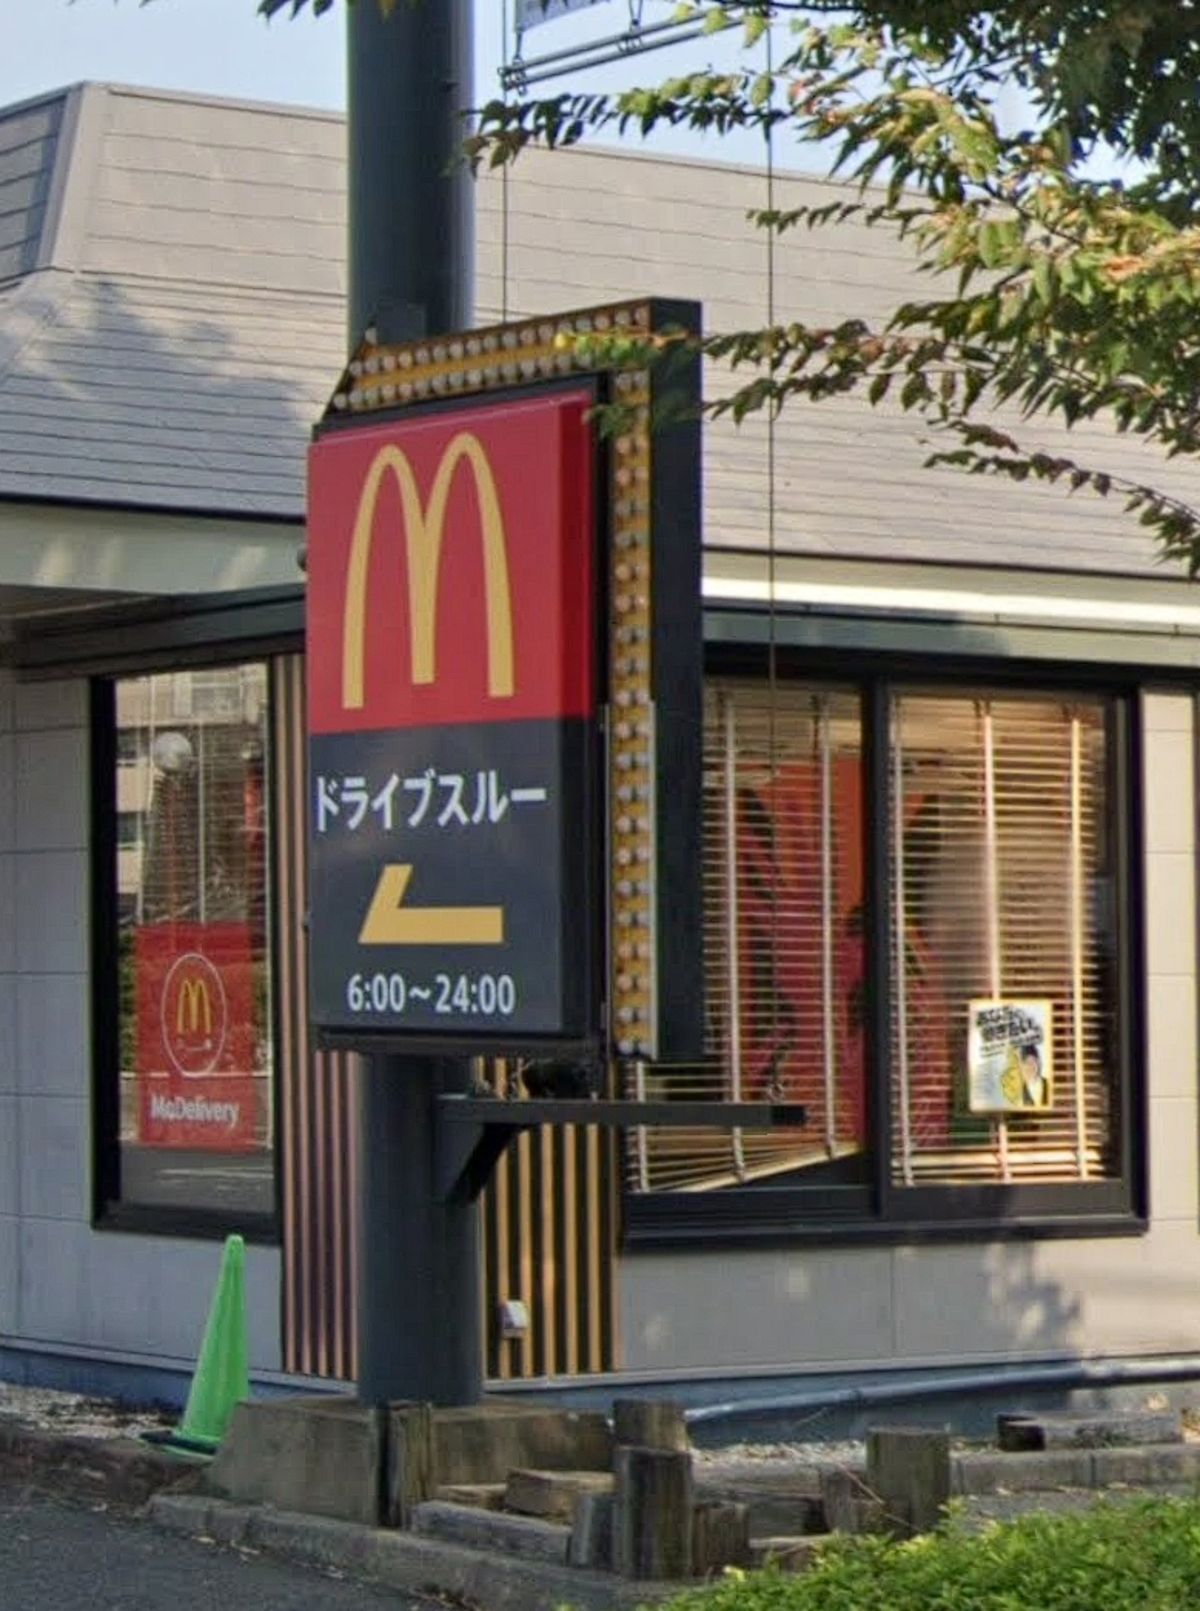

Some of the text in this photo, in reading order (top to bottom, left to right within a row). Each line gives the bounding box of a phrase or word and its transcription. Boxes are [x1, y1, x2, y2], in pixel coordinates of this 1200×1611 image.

[317, 769, 547, 832] ドライブスルー
